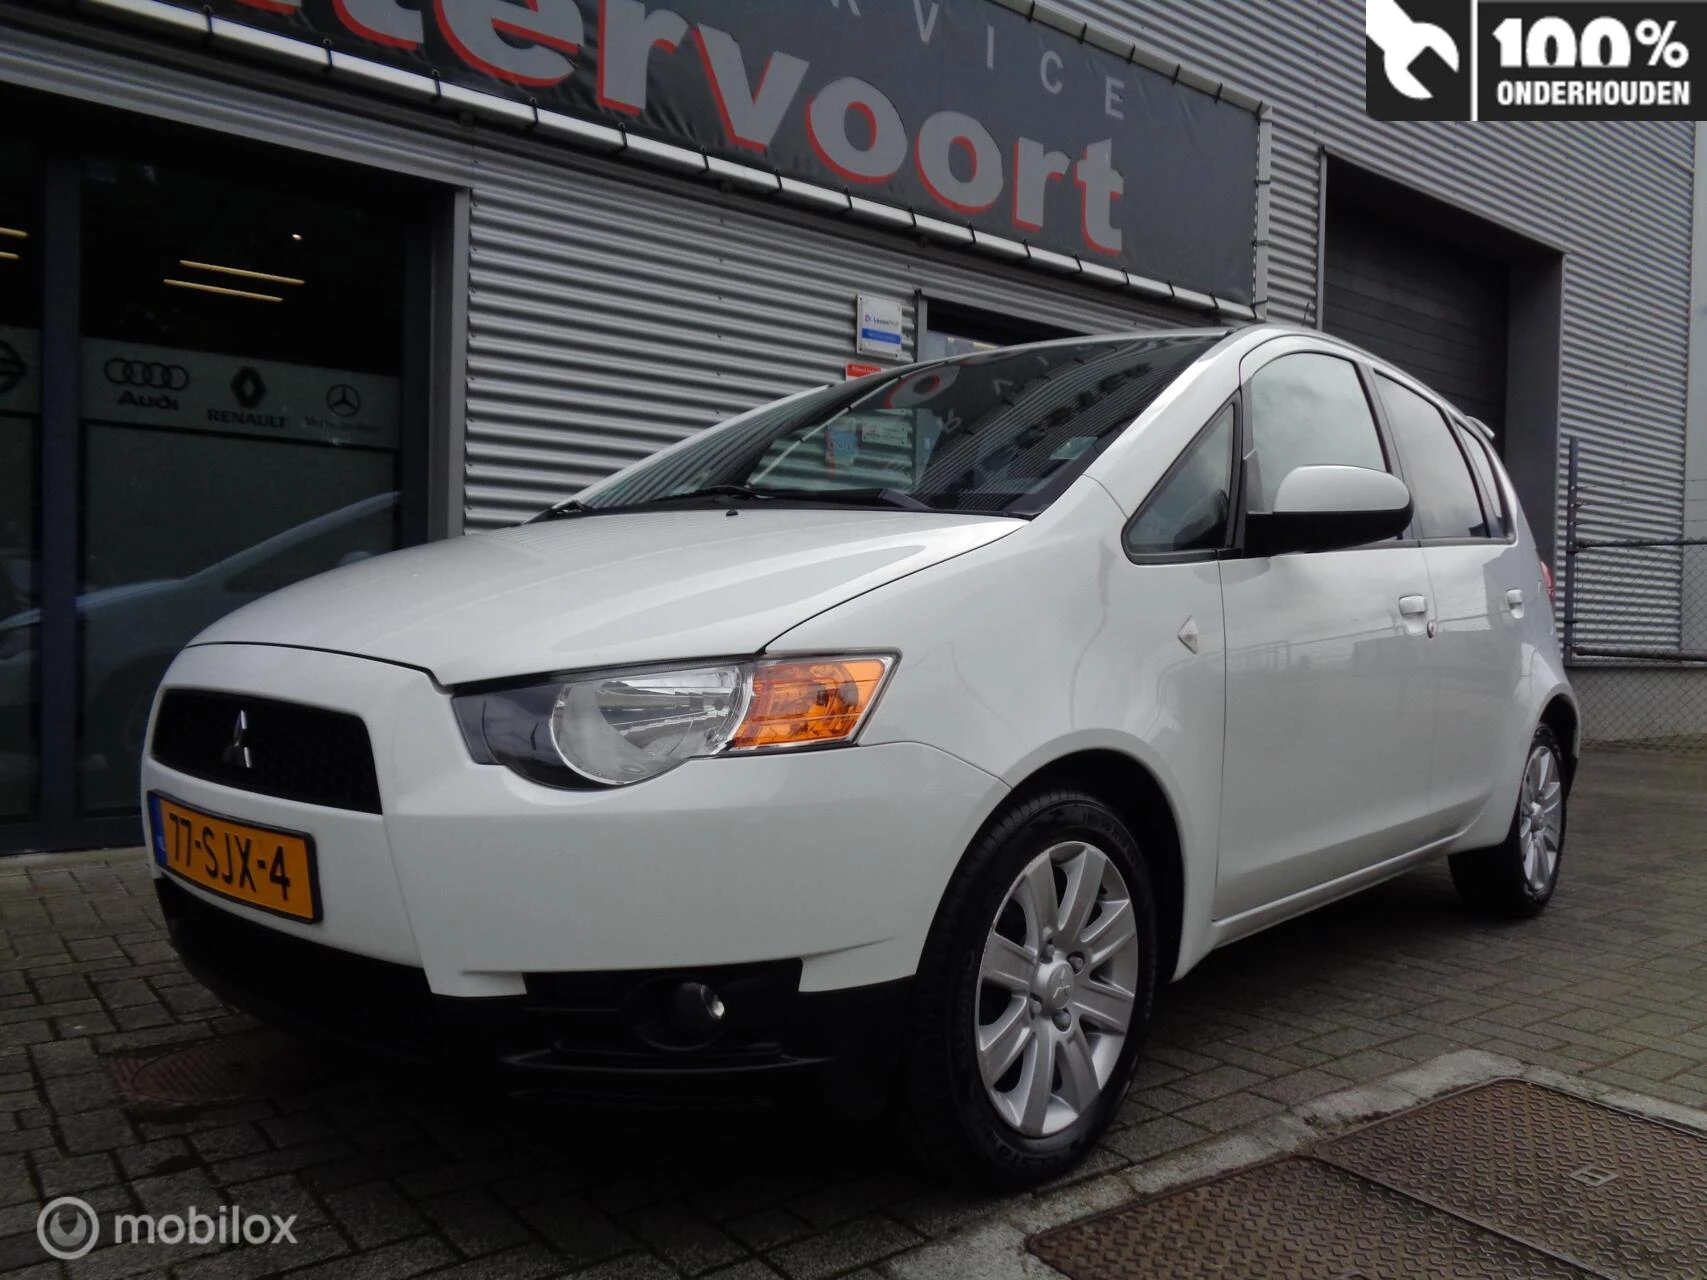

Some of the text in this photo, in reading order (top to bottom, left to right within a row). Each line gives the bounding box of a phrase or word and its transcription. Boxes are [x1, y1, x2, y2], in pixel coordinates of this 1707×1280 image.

[117, 390, 179, 412] Audi
[207, 407, 288, 429] RENAULT
[169, 812, 291, 901] 77-SJX-4
